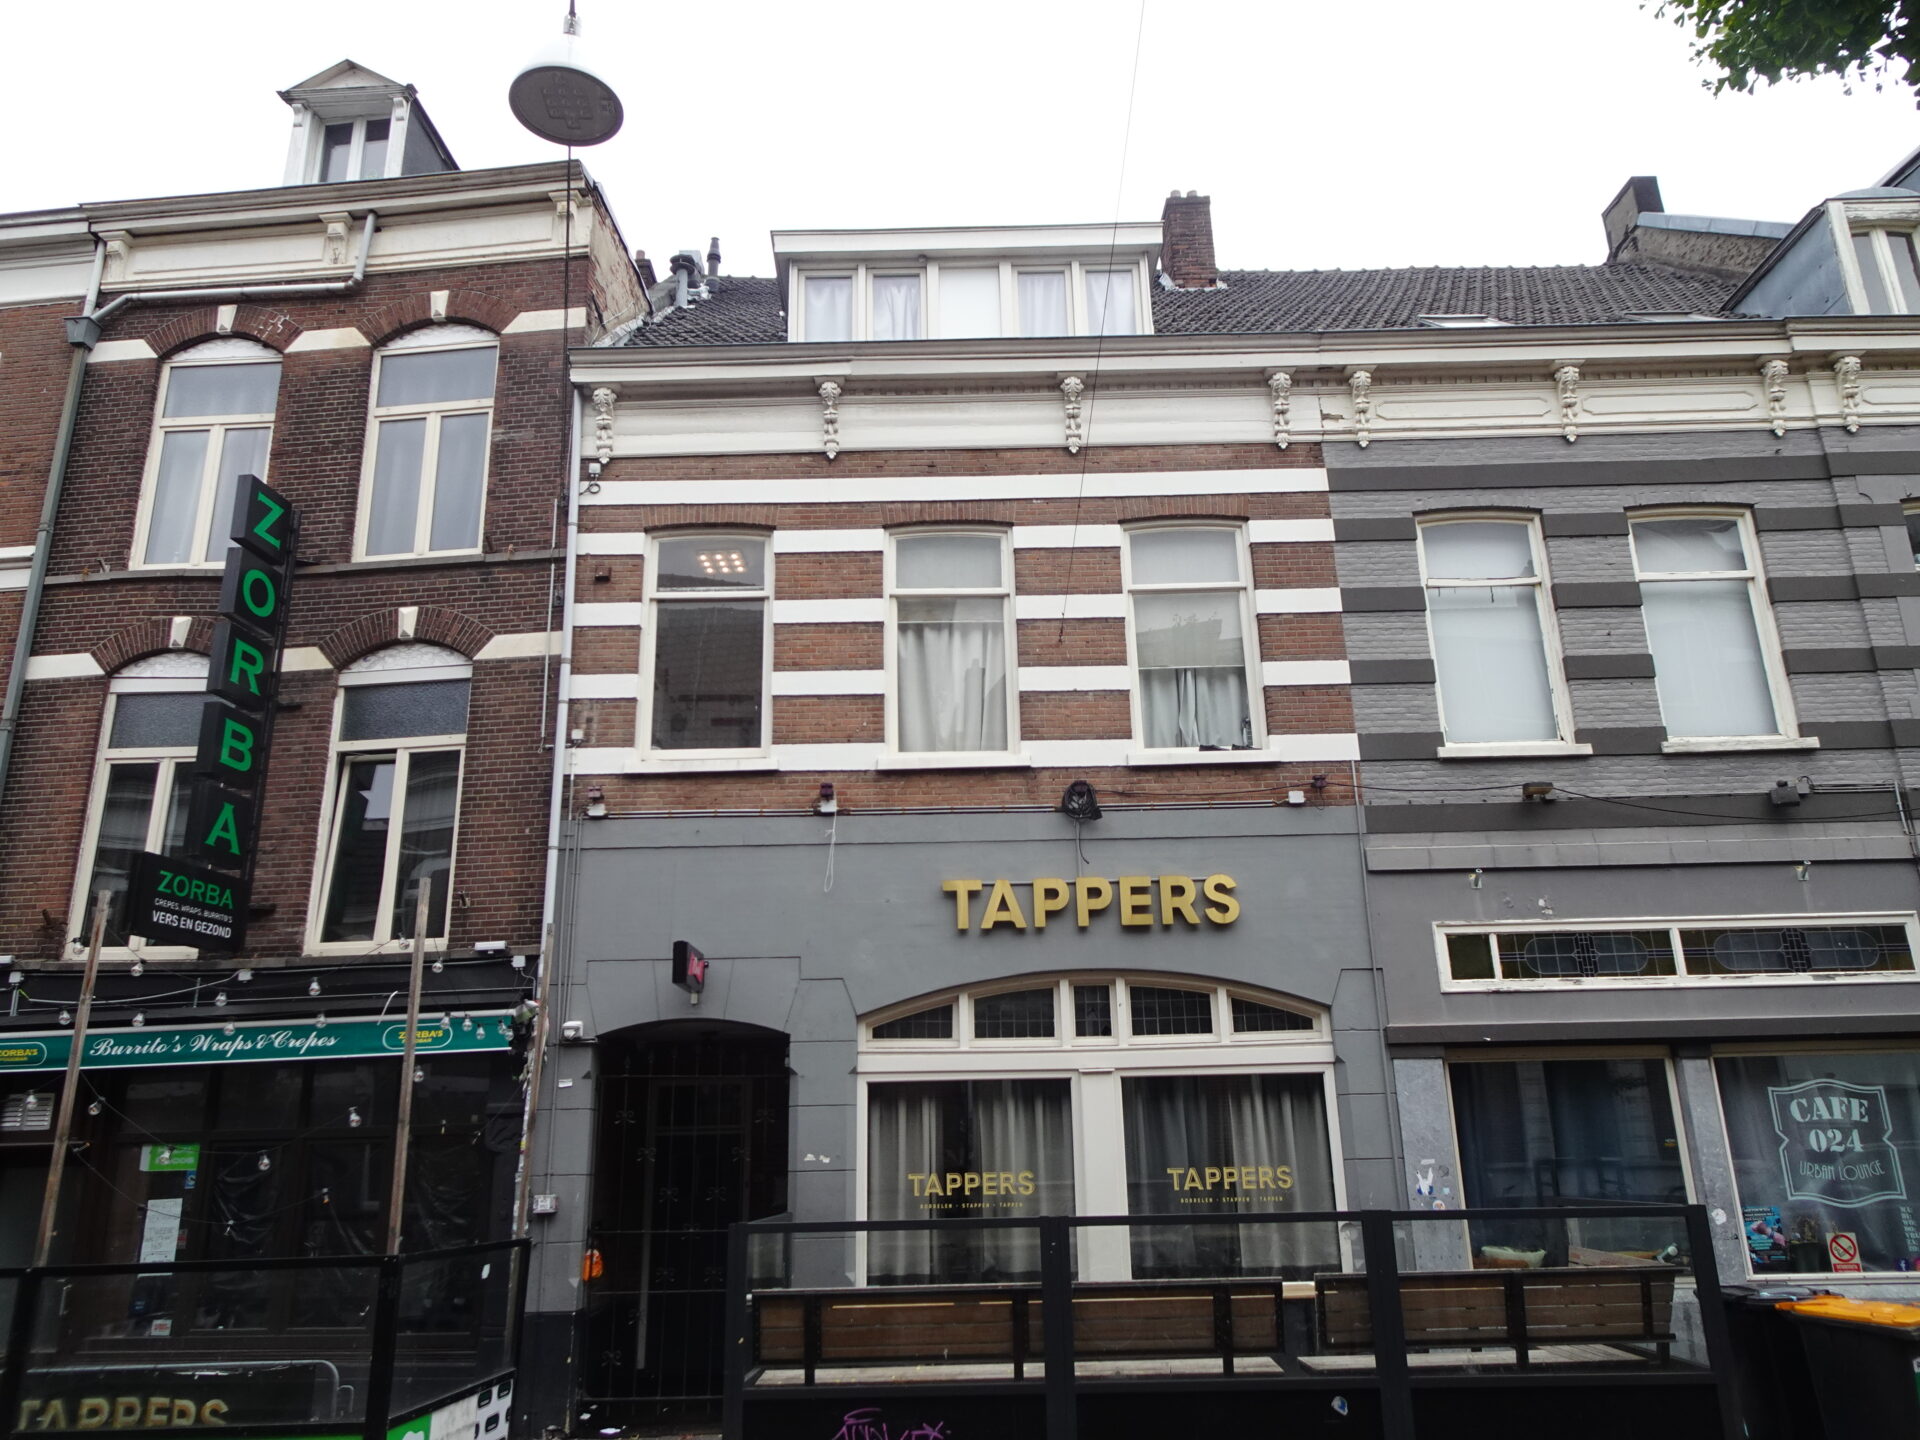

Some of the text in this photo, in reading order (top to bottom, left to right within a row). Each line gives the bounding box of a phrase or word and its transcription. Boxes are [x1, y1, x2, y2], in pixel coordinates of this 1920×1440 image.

[204, 491, 286, 855] ZORBA
[157, 870, 233, 909] ZORBA
[942, 873, 1241, 930] TAPPERS
[152, 910, 232, 939] VERS EN GEZOND
[89, 1034, 185, 1057] Burrito's
[189, 1033, 255, 1058] Wraps
[271, 1030, 340, 1055] Crepes
[398, 1030, 443, 1040] ZRBA'S
[1789, 1096, 1869, 1123] CAFE
[1809, 1128, 1864, 1153] 024
[907, 1169, 1036, 1197] TAPPERS
[1166, 1164, 1294, 1192] TAPPERS
[1800, 1159, 1886, 1181] URBAN LOUNGE
